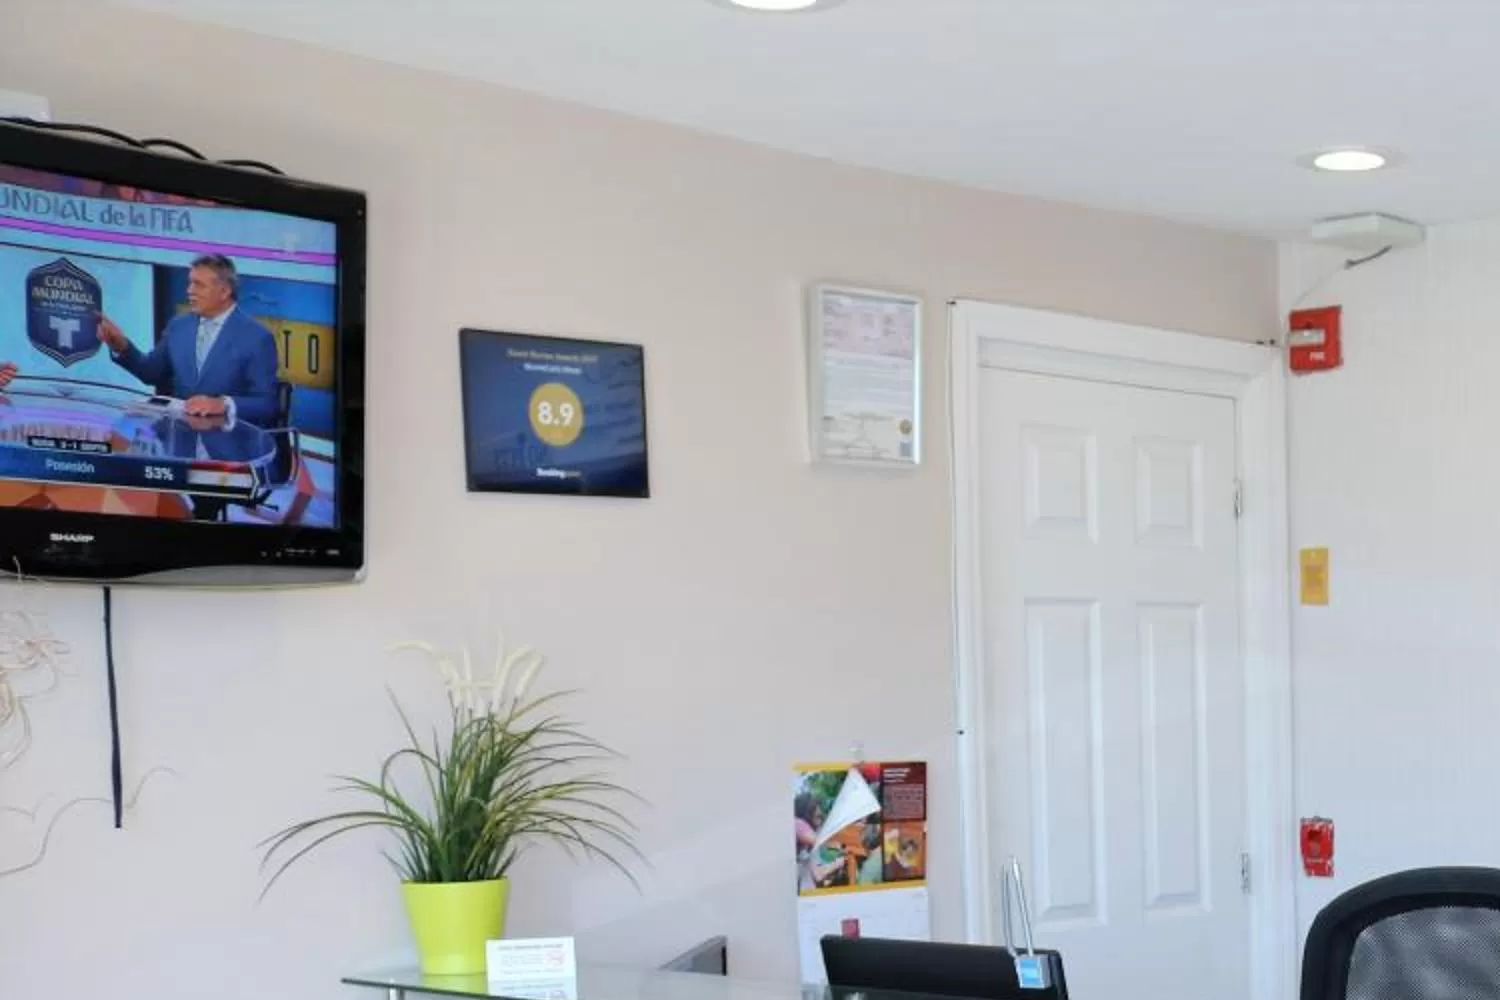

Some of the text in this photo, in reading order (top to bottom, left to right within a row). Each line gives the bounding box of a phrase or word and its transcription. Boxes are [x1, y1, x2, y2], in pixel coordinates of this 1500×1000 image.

[101, 204, 125, 226] de
[129, 206, 146, 227] la
[151, 207, 193, 233] FIFA
[538, 400, 575, 426] 8.9
[144, 466, 174, 481] 53%
[50, 533, 95, 543] SHARP
